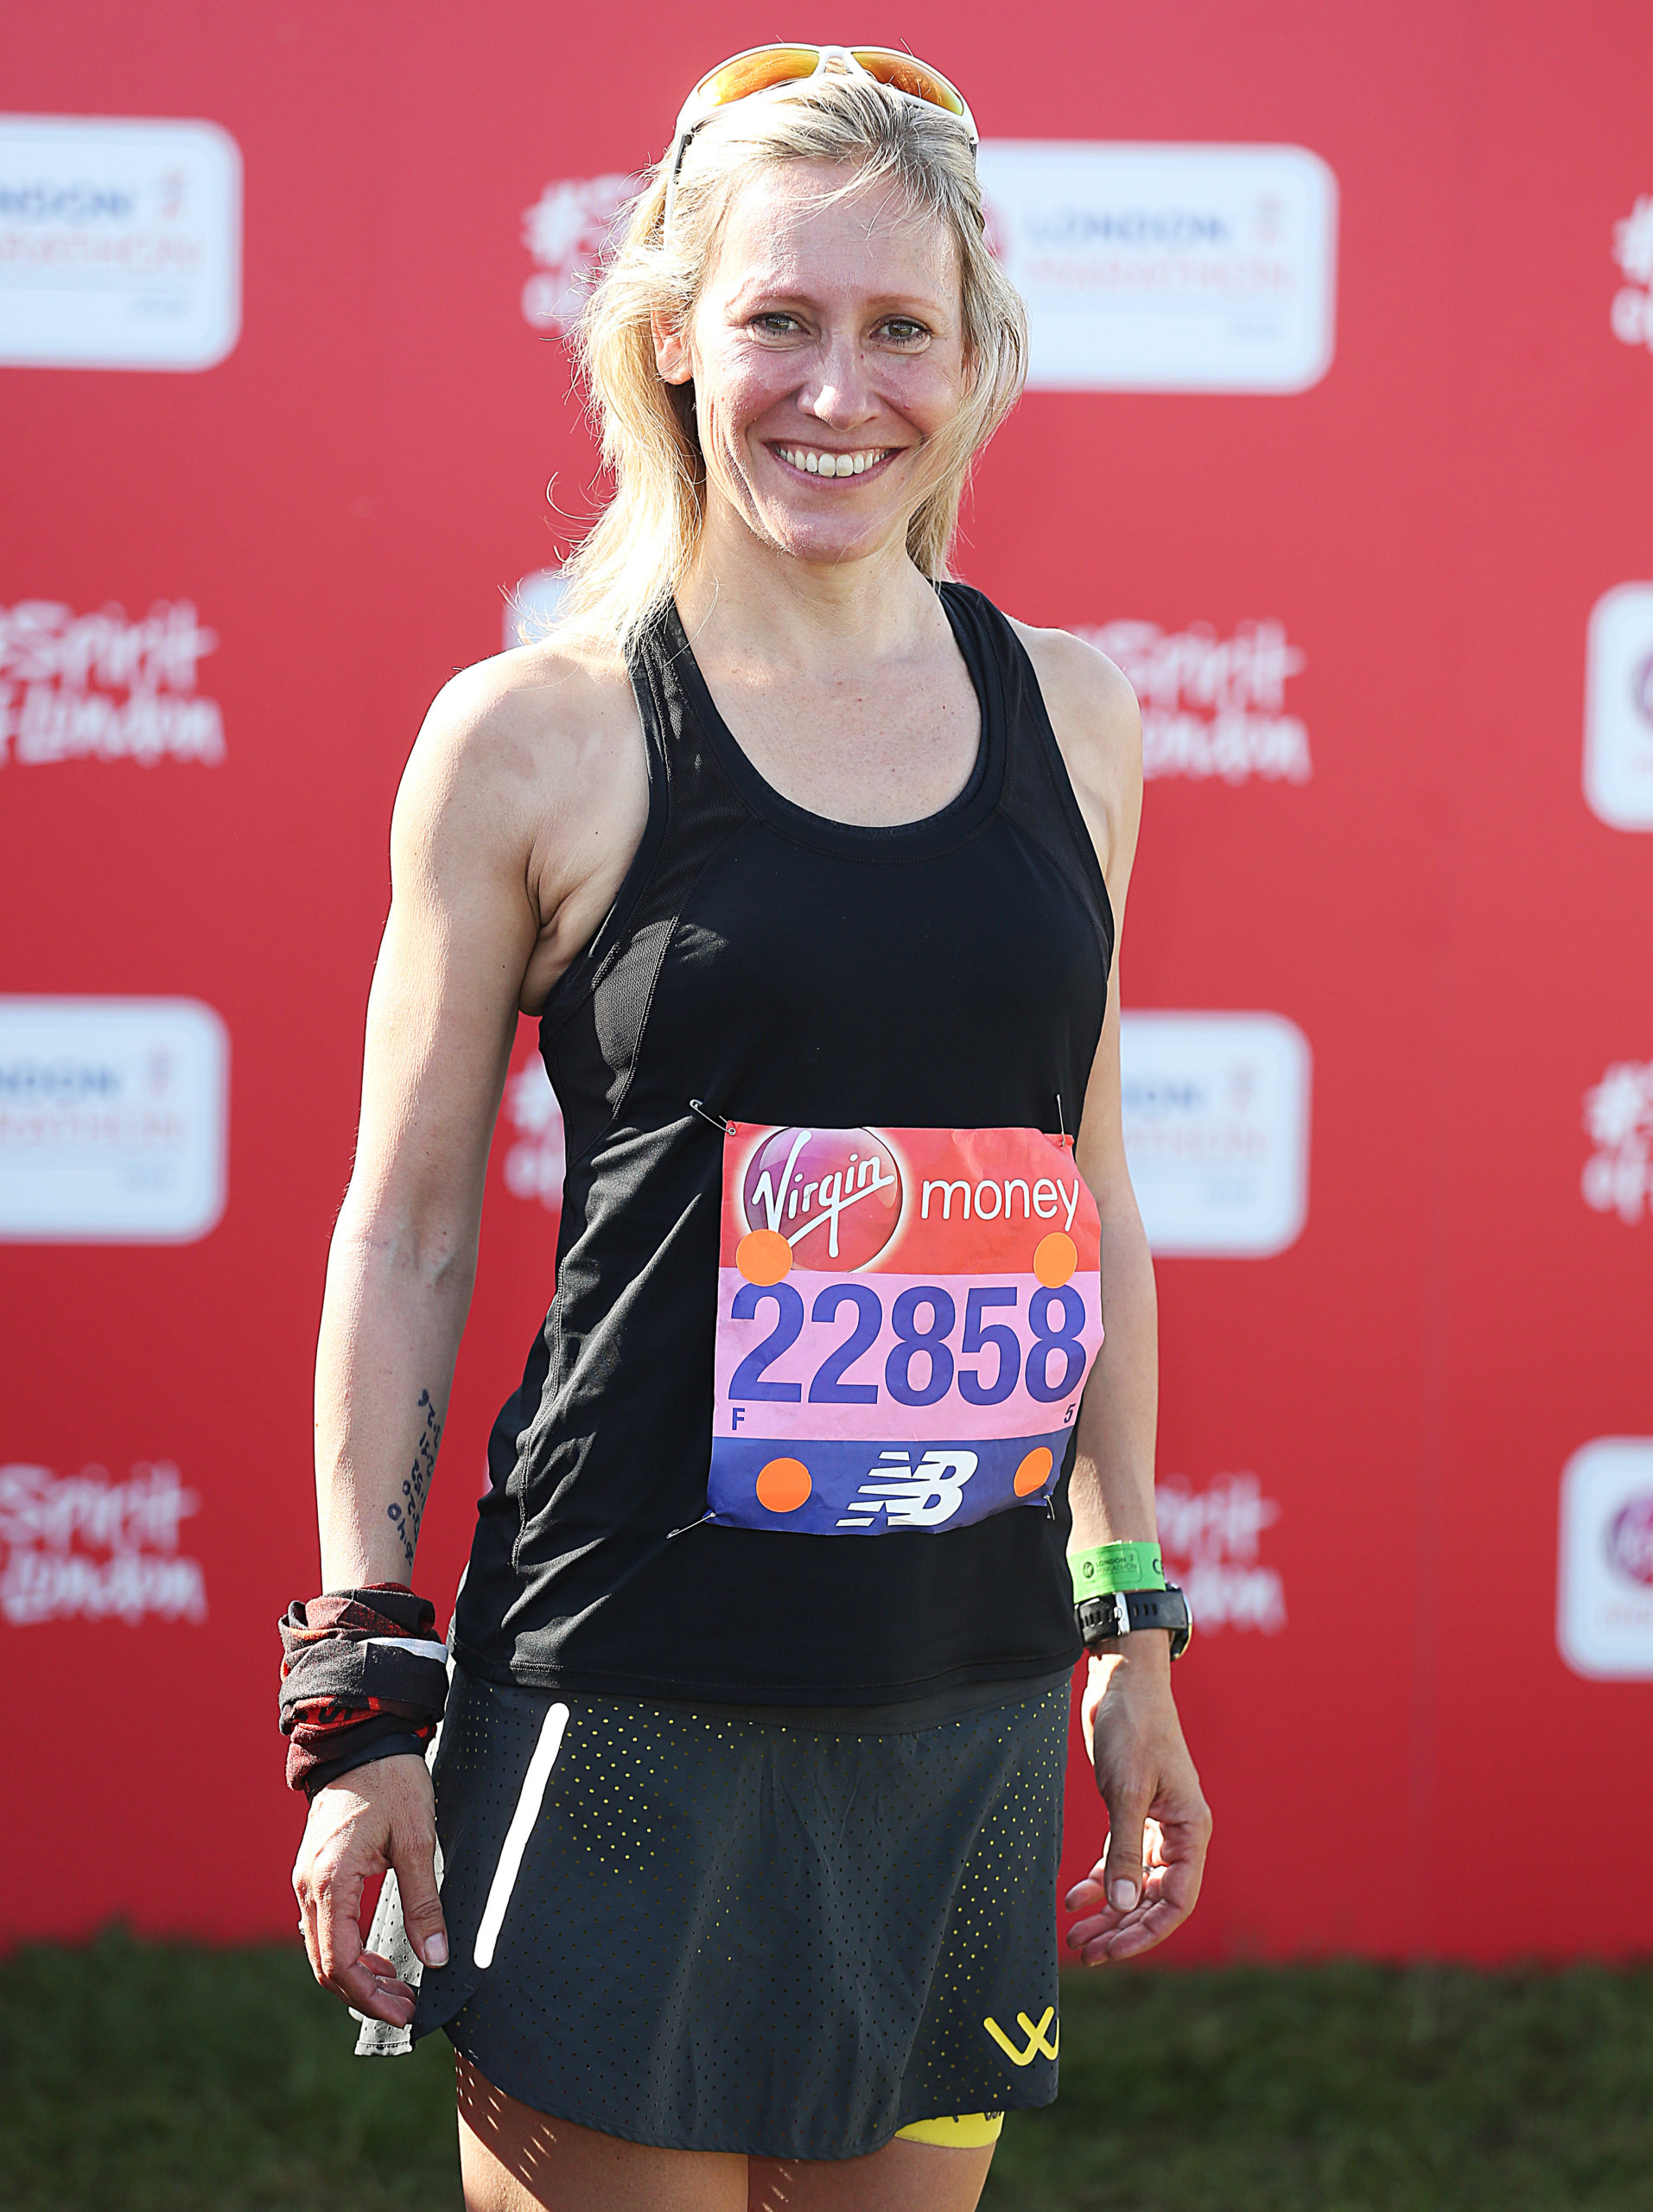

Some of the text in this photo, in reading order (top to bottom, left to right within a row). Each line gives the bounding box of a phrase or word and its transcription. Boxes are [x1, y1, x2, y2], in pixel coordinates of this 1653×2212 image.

[751, 1129, 1079, 1258] Virgin money
[728, 1281, 1087, 1407] 22858
[731, 1408, 746, 1431] F
[1064, 1403, 1075, 1424] 5
[1095, 1558, 1127, 1569] LONDON
